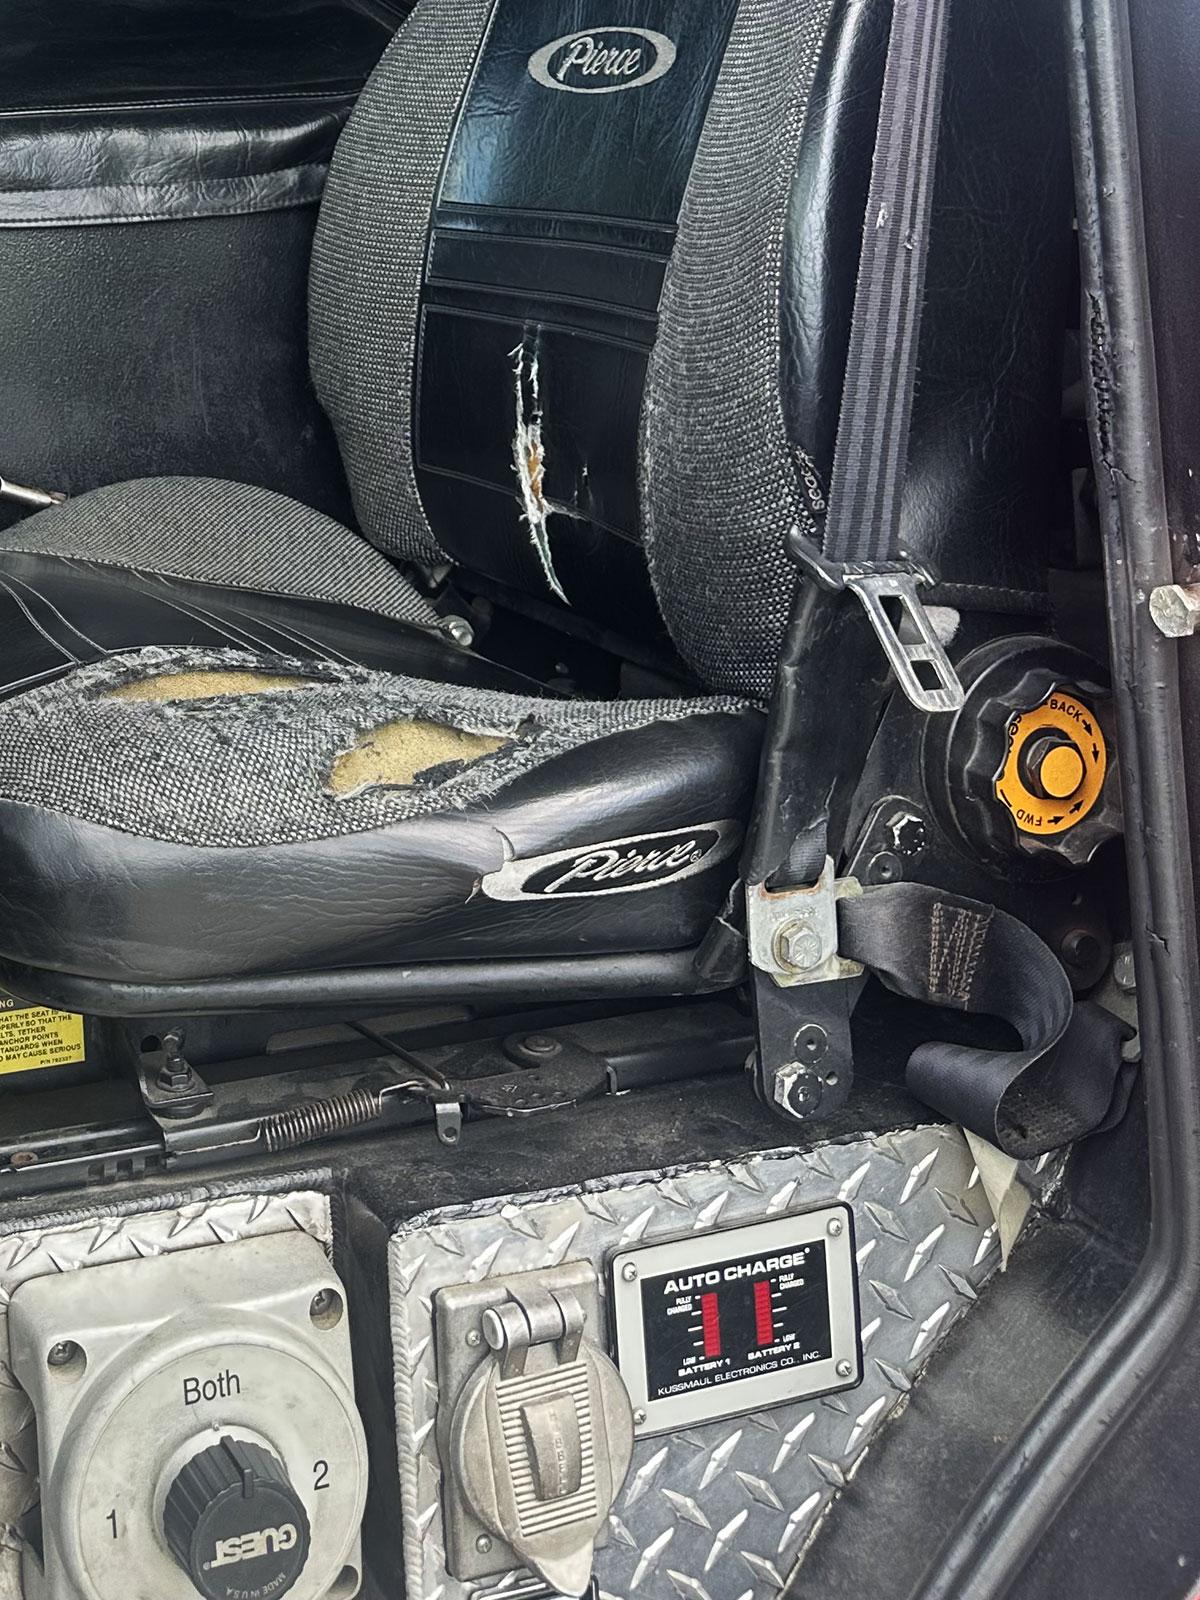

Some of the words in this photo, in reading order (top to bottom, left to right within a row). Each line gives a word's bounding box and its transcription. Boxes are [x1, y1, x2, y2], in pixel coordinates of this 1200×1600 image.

[556, 37, 641, 80] Pierce
[1050, 700, 1083, 722] BACK
[1017, 809, 1042, 826] FWD
[544, 840, 695, 892] Pierce
[16, 1012, 30, 1020] THE
[32, 1010, 49, 1018] SEAT
[38, 1017, 56, 1025] THAT
[0, 1036, 30, 1046] ANCHOR
[32, 1032, 58, 1041] POINTS
[18, 1026, 46, 1035] TETHER
[42, 1039, 63, 1047] WHEN
[6, 1053, 21, 1061] MAY
[23, 1049, 48, 1058] CAUSE
[50, 1044, 81, 1054] SERIOUS
[663, 1270, 720, 1294] AUTO
[724, 1252, 806, 1282] CHARGE
[779, 1273, 795, 1283] FULLY
[780, 1278, 804, 1290] CHARGED
[666, 1303, 692, 1315] CHARGED
[676, 1296, 692, 1307] FULLY
[783, 1333, 796, 1342] LOW
[748, 1344, 792, 1360] BATTERY
[794, 1342, 800, 1350] 2
[678, 1360, 723, 1377] BATTERY
[726, 1358, 731, 1366] 1
[683, 1355, 696, 1366] LOW
[658, 1378, 712, 1396] KUSSMAUL
[715, 1360, 778, 1382] ELECTRONICS
[803, 1350, 821, 1360] INC.
[183, 1370, 241, 1406] Both
[313, 1460, 330, 1490] 2
[106, 1509, 118, 1539] 1
[211, 1523, 297, 1568] GUEST
[263, 1572, 286, 1595] MADE
[251, 1590, 260, 1598] IN
